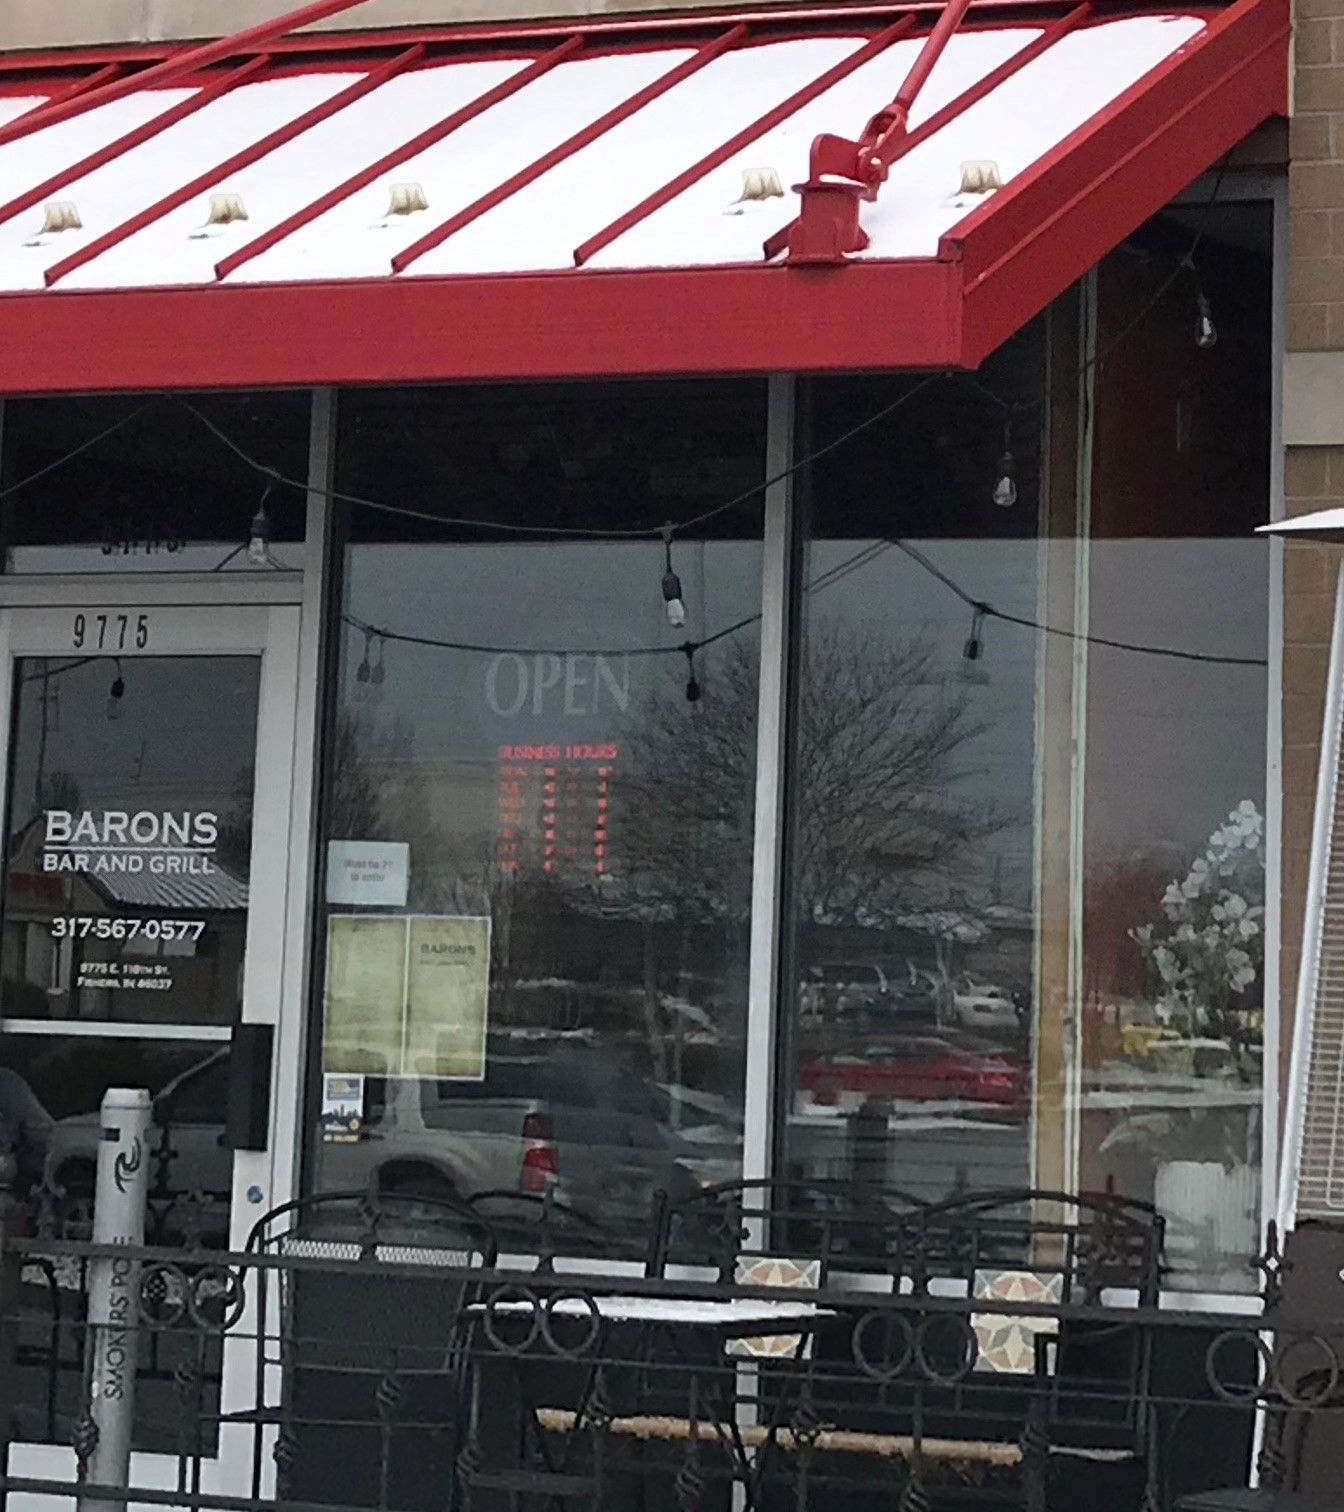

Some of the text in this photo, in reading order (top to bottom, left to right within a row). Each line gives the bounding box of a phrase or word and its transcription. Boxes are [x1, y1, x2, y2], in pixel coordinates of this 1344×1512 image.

[73, 614, 148, 648] 9775
[485, 652, 631, 715] OPEN
[44, 809, 218, 844] BARONS
[42, 853, 216, 875] BAR AND GRILL
[51, 917, 206, 941] 317-567-0577
